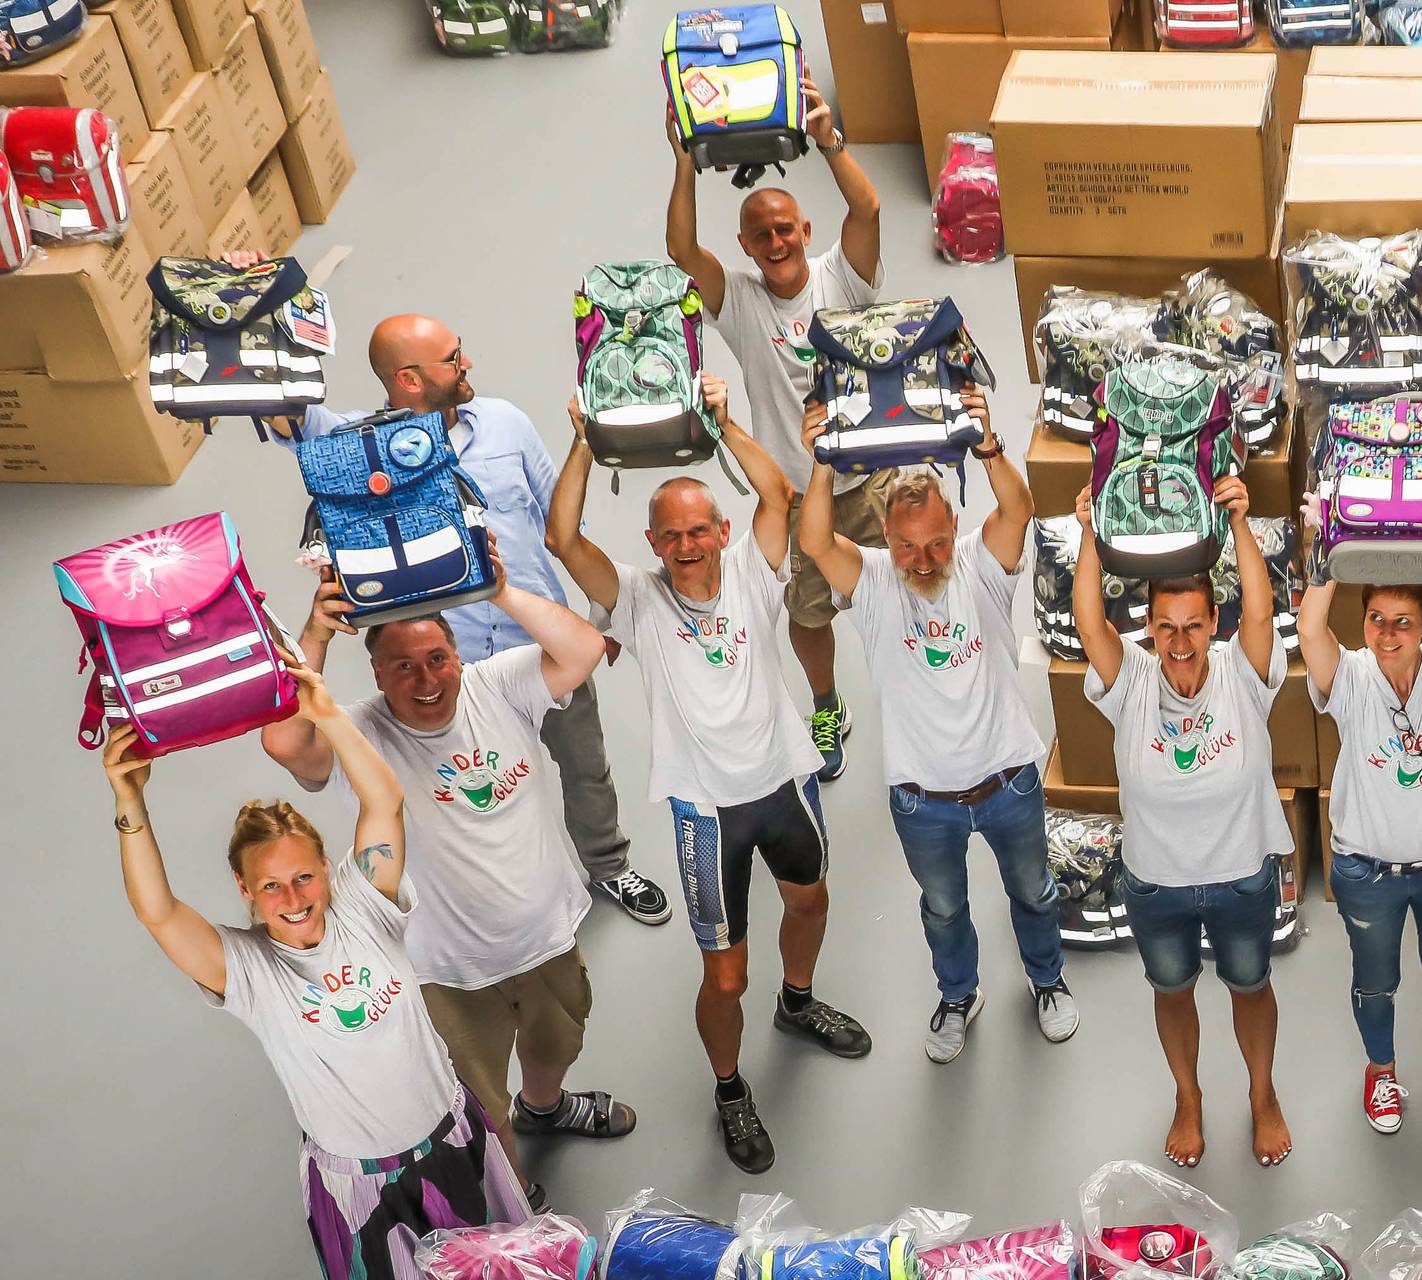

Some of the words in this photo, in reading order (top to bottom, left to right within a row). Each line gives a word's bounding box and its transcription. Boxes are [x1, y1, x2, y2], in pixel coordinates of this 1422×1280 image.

[1151, 711, 1214, 753] KINDER
[1198, 729, 1237, 765] GLÜCK
[434, 748, 500, 802] KINDER
[493, 758, 530, 801] GLÜCK
[301, 964, 371, 1023] KINDER
[367, 974, 402, 1022] GLÜCK
